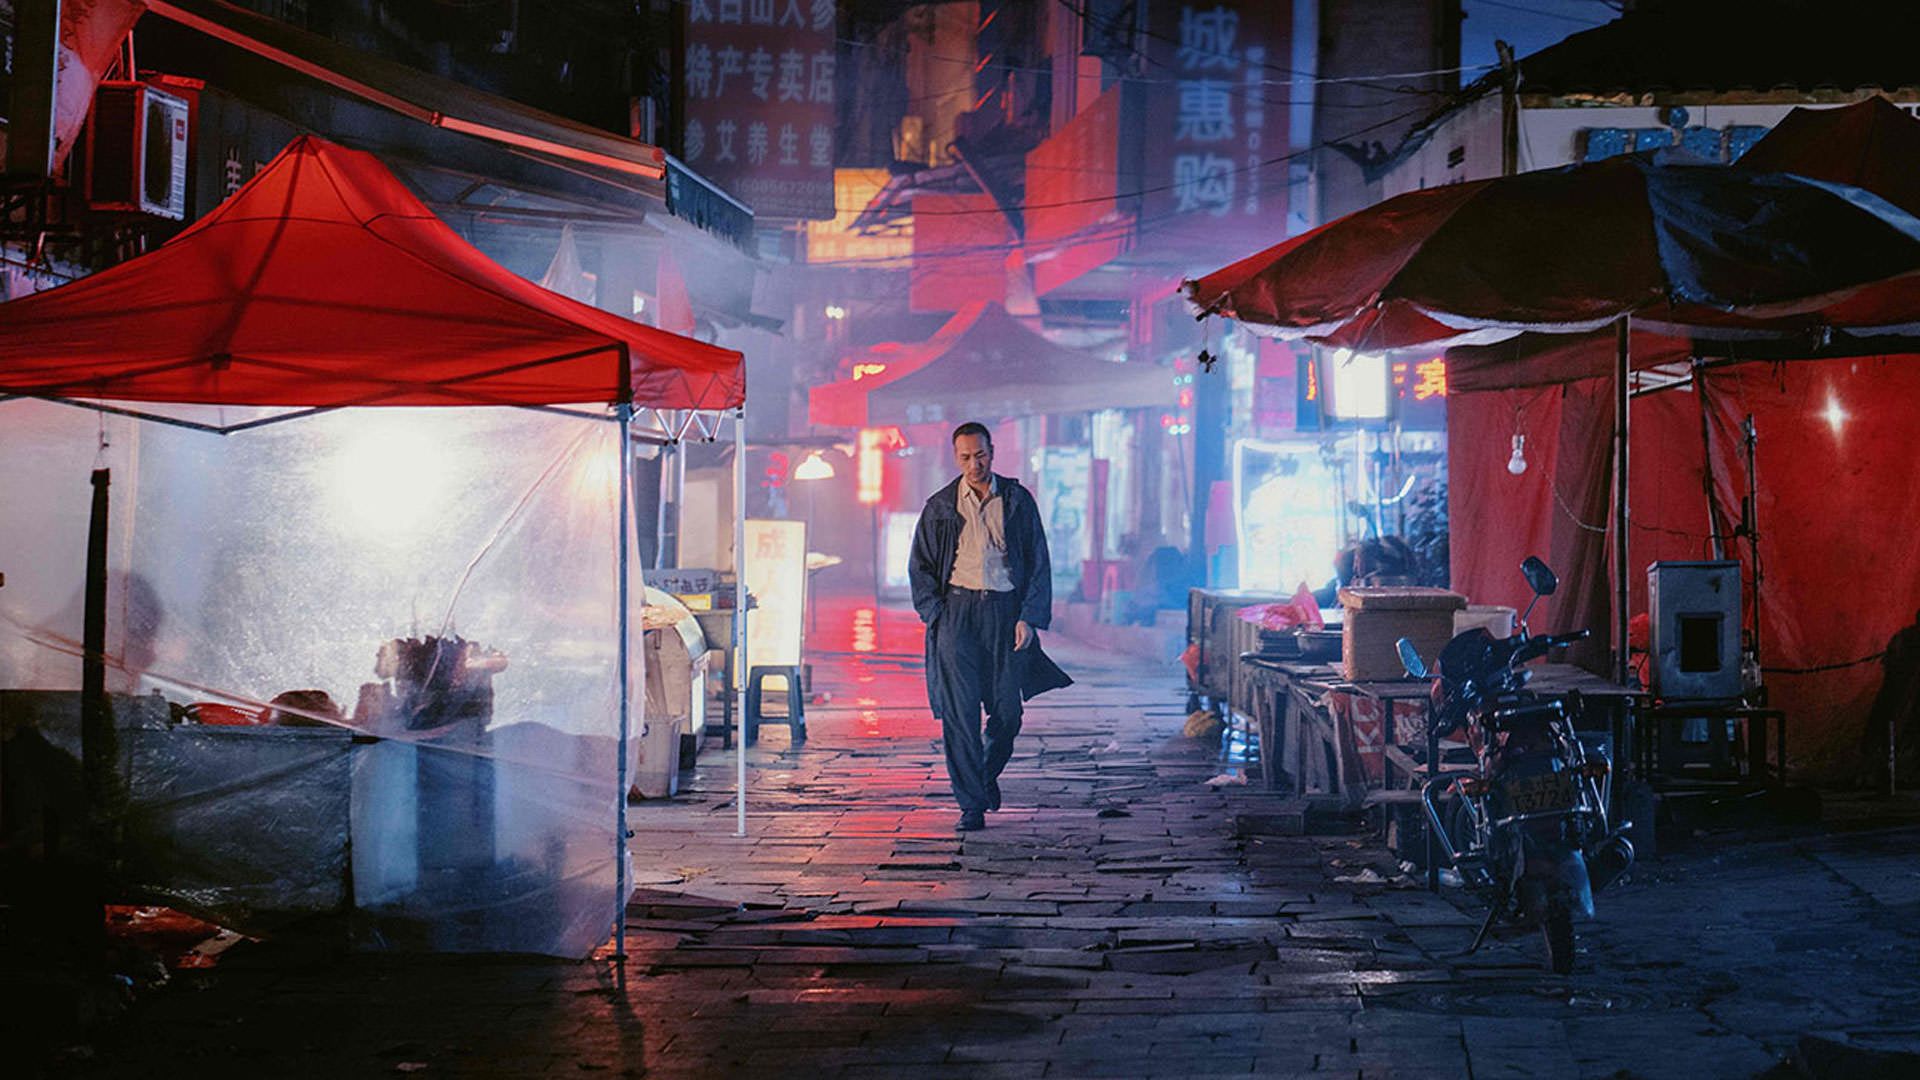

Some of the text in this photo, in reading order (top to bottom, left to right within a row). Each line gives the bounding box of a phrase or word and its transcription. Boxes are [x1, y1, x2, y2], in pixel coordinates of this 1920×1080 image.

[685, 43, 836, 104] 特产专卖店
[684, 118, 832, 167] 参艾养生堂
